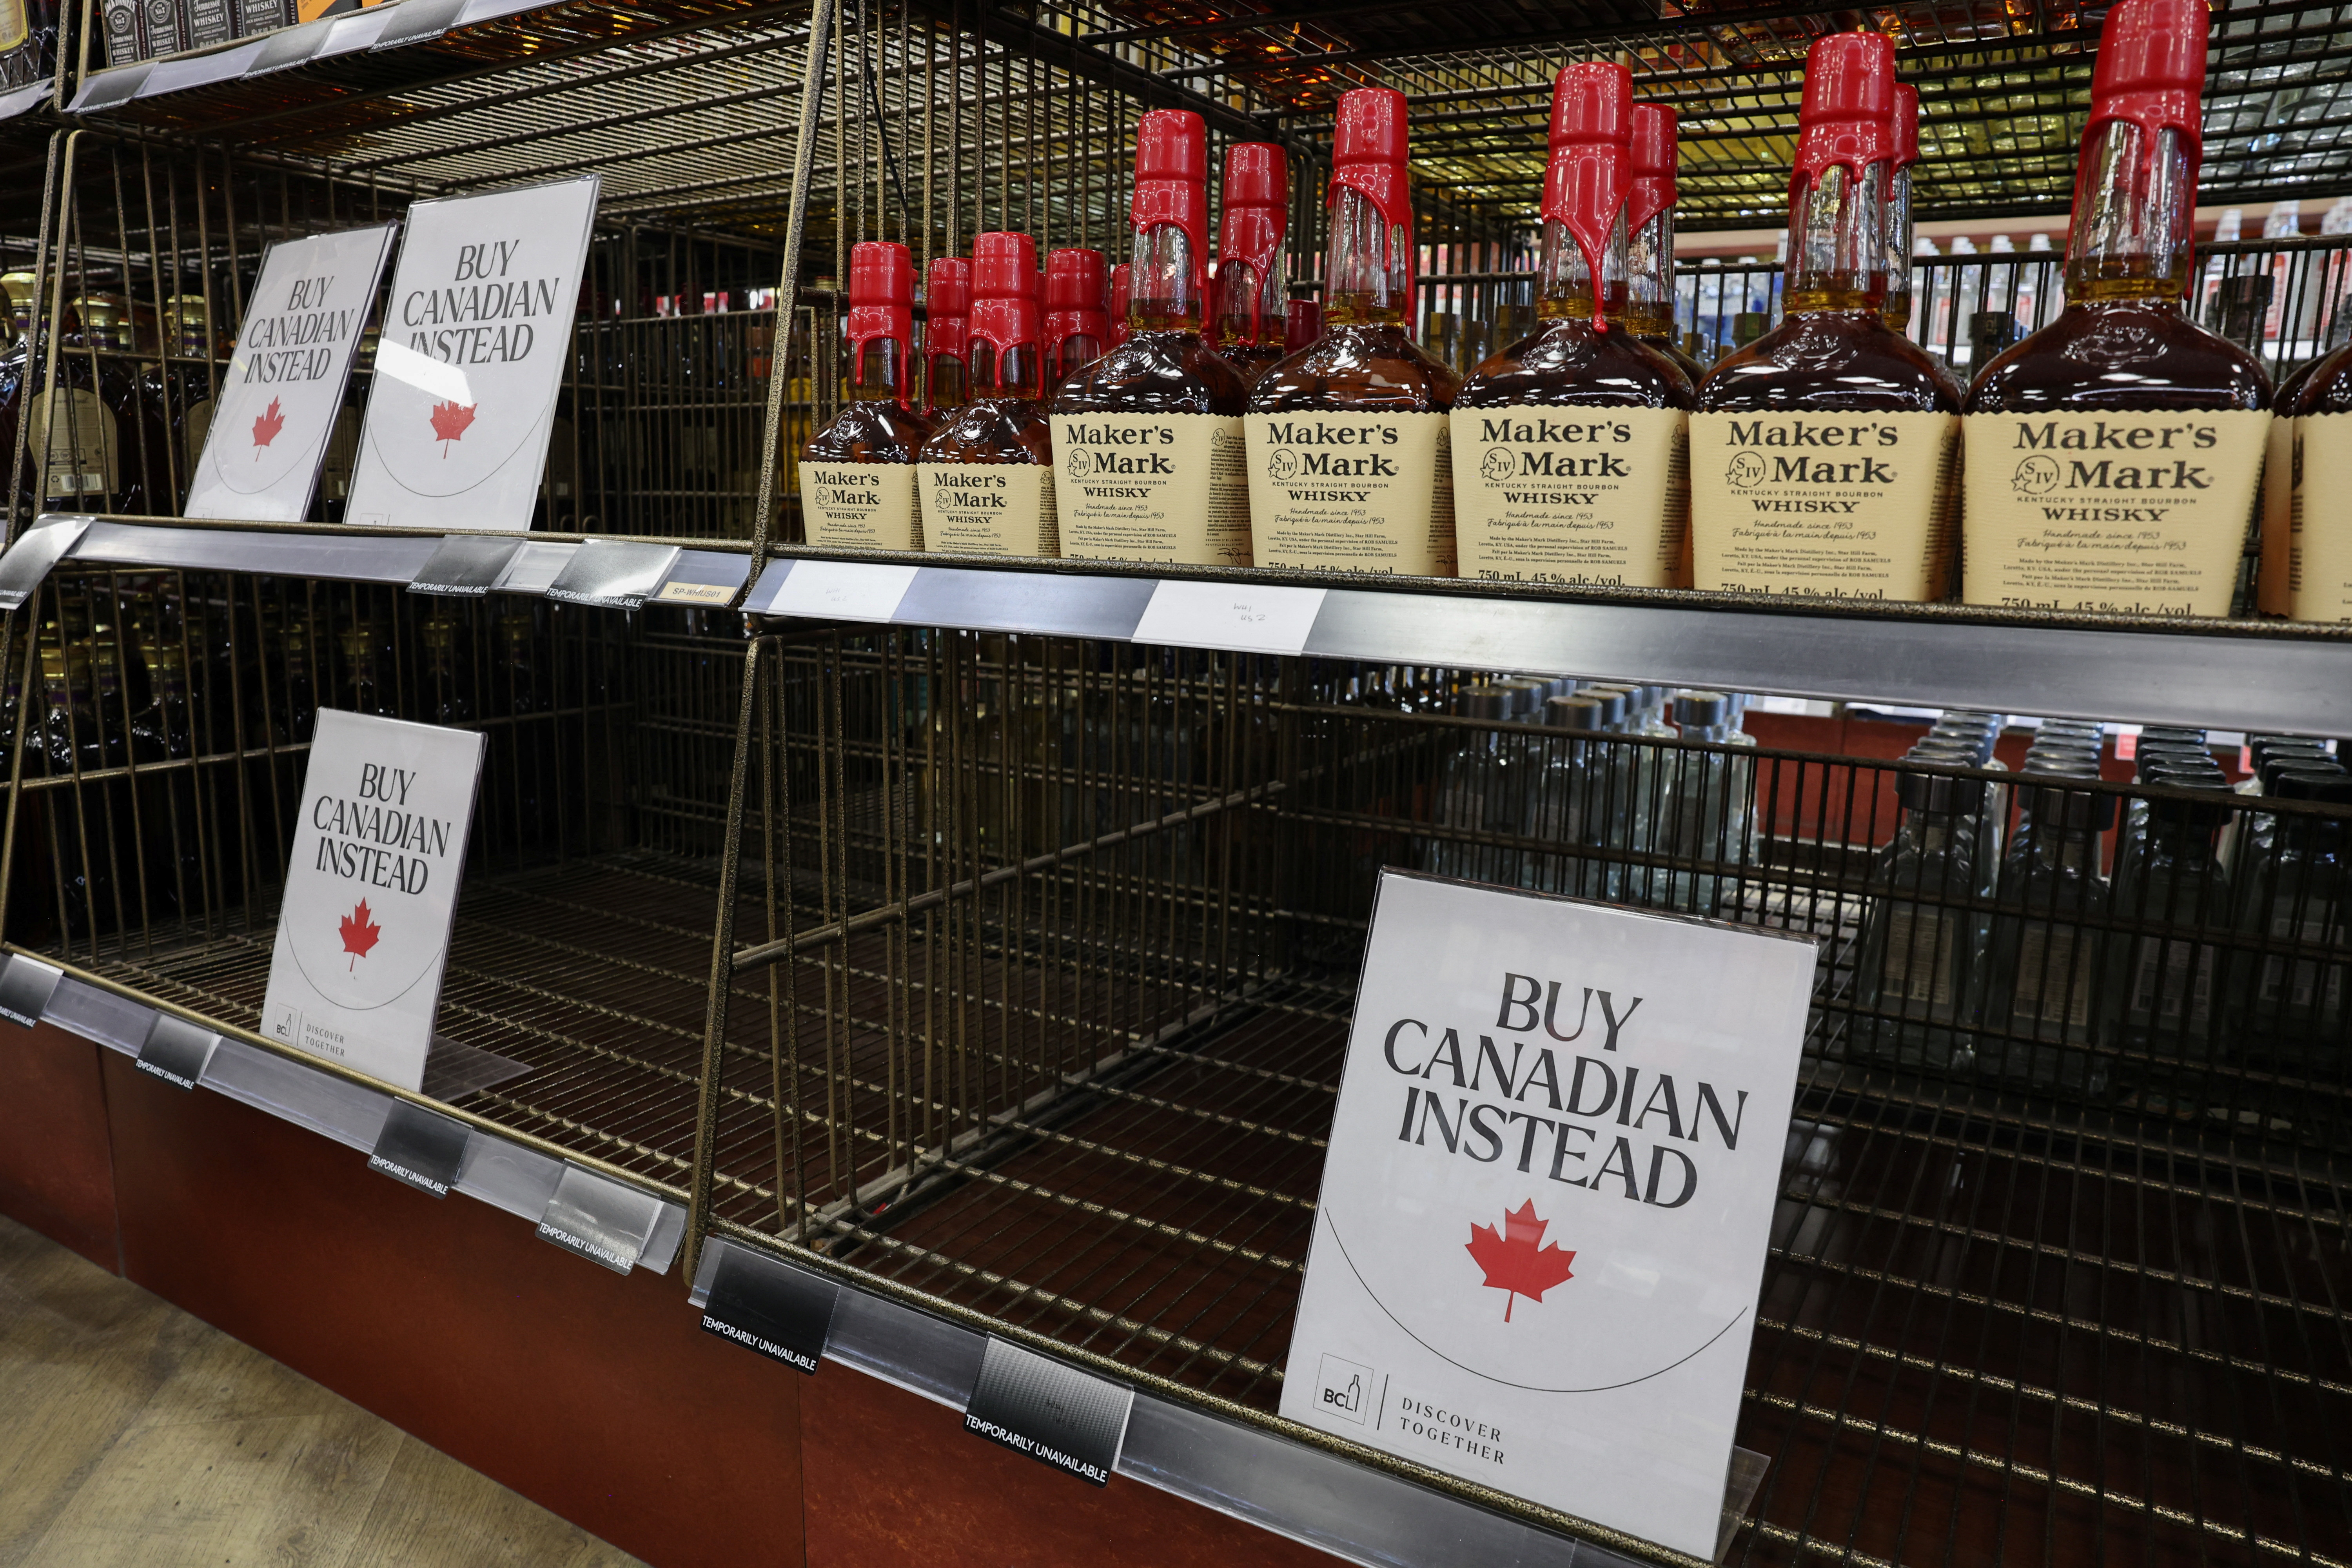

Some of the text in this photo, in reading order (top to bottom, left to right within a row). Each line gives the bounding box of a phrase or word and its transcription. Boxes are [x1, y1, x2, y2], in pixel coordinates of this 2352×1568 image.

[245, 0, 278, 14] WHISKEY
[194, 13, 224, 27] WHISKEY
[152, 36, 174, 47] WHISKEY
[371, 27, 447, 50] TEMPORARILY UNAVAILABLE
[112, 46, 134, 56] WHISKEY
[454, 239, 520, 281] BUY
[287, 276, 334, 311] BUY
[403, 278, 560, 327] CANADIAN
[248, 308, 354, 348] CANADIAN
[244, 348, 331, 384] INSTEAD
[1066, 424, 1174, 445] Maker's
[1267, 422, 1398, 445] Maker's
[1480, 419, 1631, 443] Maker's
[1726, 421, 1898, 447] Maker's
[2013, 422, 2217, 450] Maker's
[814, 471, 879, 486] Maker's
[934, 472, 1006, 488] Maker's
[1083, 486, 1151, 498] WHISKY
[1288, 490, 1370, 502] WHISKY
[1503, 492, 1599, 505] WHISKY
[826, 512, 867, 520] WHISKY
[1074, 510, 1097, 520] Fabriqué
[1128, 512, 1150, 521] depuis
[1752, 499, 1860, 513] WHISKY
[2042, 508, 2170, 522] WHISKY
[946, 515, 992, 524] WHISKY
[1274, 515, 1303, 525] Fabriqué
[1343, 517, 1368, 526] depuis
[409, 582, 489, 593] TEMPORARILY UNAVAILABLE
[1478, 570, 1499, 579] 750
[1531, 572, 1546, 582] 45
[1551, 573, 1565, 583] %
[547, 588, 643, 608] TEMPORARILY UNAVAILABLE
[673, 588, 721, 598] SP-WHIUS01
[359, 763, 416, 806] BUY
[313, 796, 451, 857] CANADIAN
[316, 836, 428, 895] INSTEAD
[10, 1011, 36, 1027] UNAVAILABLE
[1496, 972, 1643, 1052] BUY
[307, 1024, 344, 1044] DISCOVER
[305, 1036, 345, 1057] TOGETHER
[136, 1058, 194, 1090] TEMPORARILY UNAVAILABLE
[1384, 1018, 1749, 1151] CANADIAN
[1398, 1086, 1698, 1209] INSTEAD
[371, 1154, 448, 1196] TEMPORARILY UNAVAILABLE
[539, 1222, 633, 1270] TEMPORARILY UNAVAILABLE
[702, 1315, 817, 1372] TEMPORARILY UNAVAILABLE
[1402, 1397, 1501, 1443] DISCOVER
[965, 1414, 1107, 1483] TEMPORARILY UNAVAILABLE
[1400, 1417, 1505, 1465] TOGETHER
